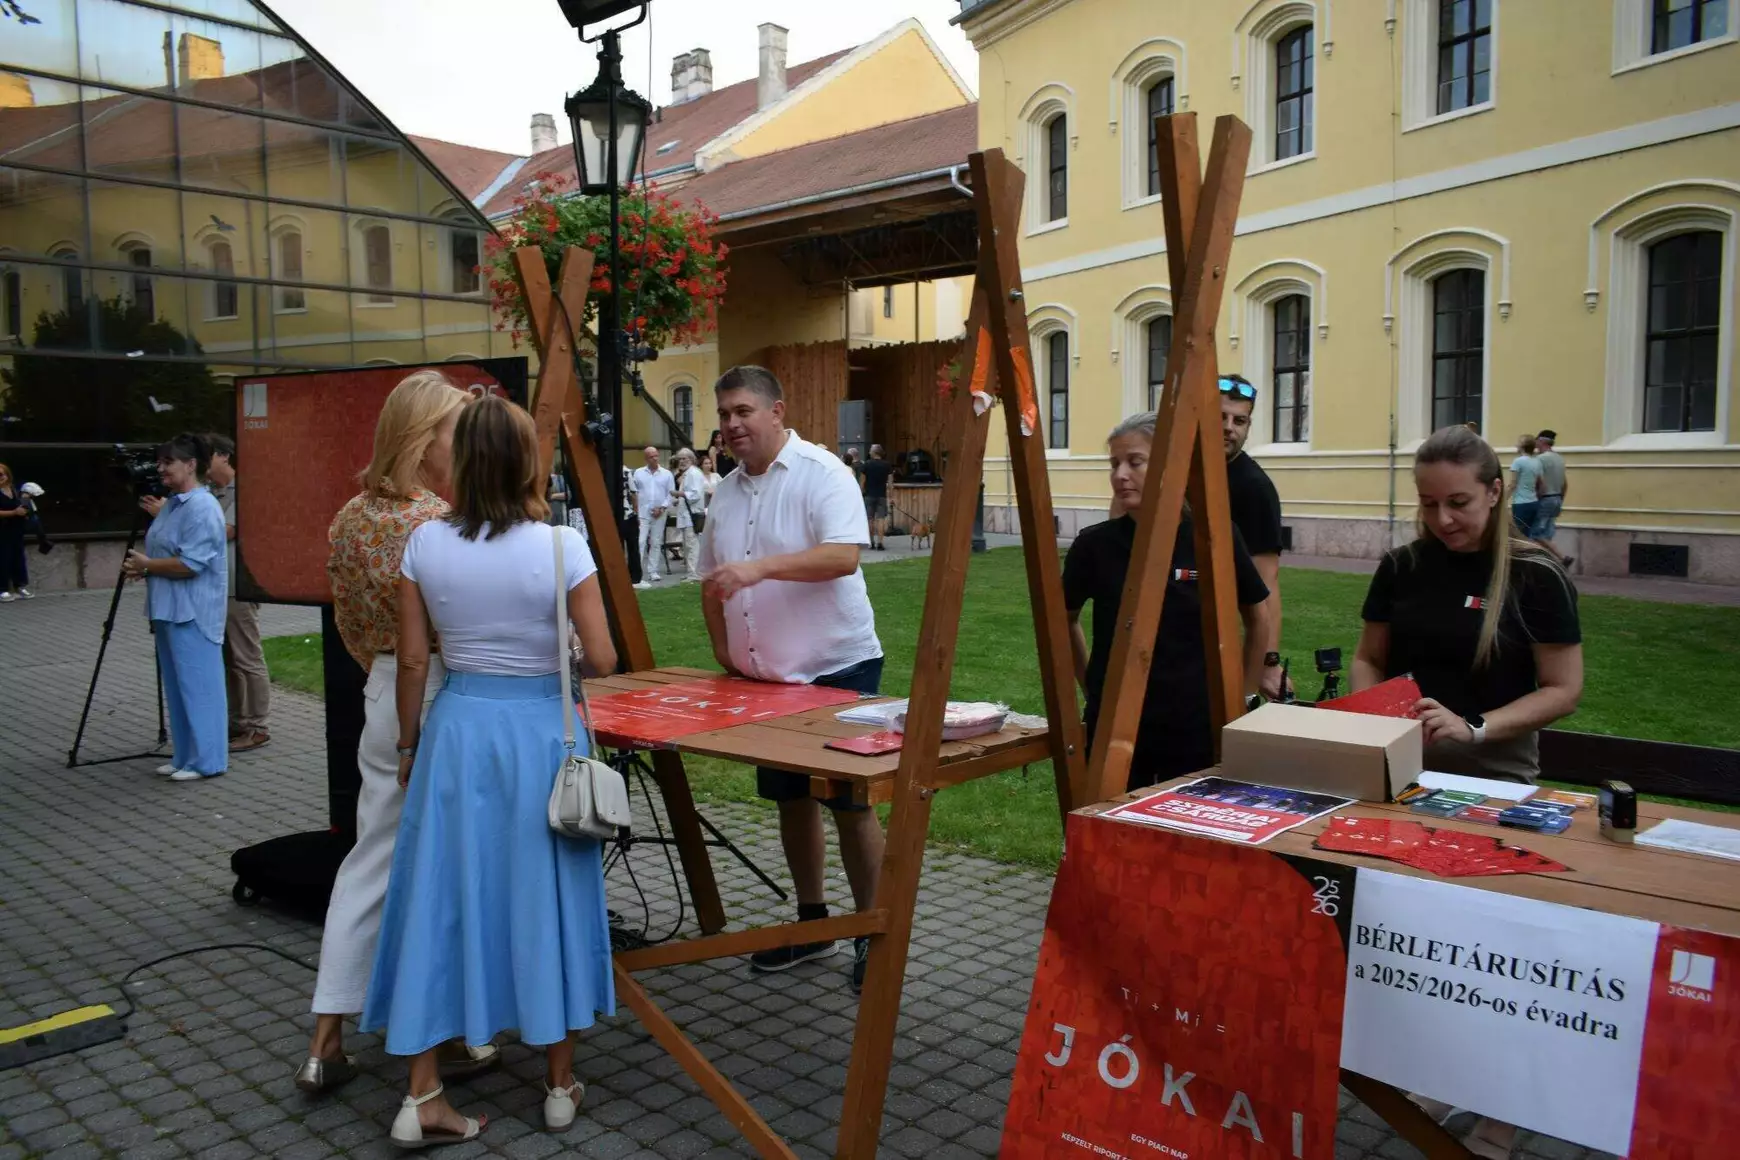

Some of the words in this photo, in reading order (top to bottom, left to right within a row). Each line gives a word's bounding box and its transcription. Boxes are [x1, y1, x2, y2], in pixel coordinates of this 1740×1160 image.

[1312, 875, 1340, 898] 25
[1311, 895, 1340, 917] 26
[1355, 923, 1626, 1002] BÉRLETÁRUSÍTÁS
[1354, 963, 1365, 979] a
[1371, 963, 1517, 1018] 2025/2026-os
[1525, 1000, 1619, 1041] évadra
[1668, 985, 1712, 1003] JÓKAI
[1044, 1022, 1304, 1159] JÓKAI
[1061, 1132, 1092, 1150] KÉPZELT
[1093, 1145, 1121, 1160] RIPORT
[1130, 1133, 1147, 1145] EGY
[1147, 1139, 1169, 1154] PIACI
[1170, 1148, 1189, 1160] NAP
